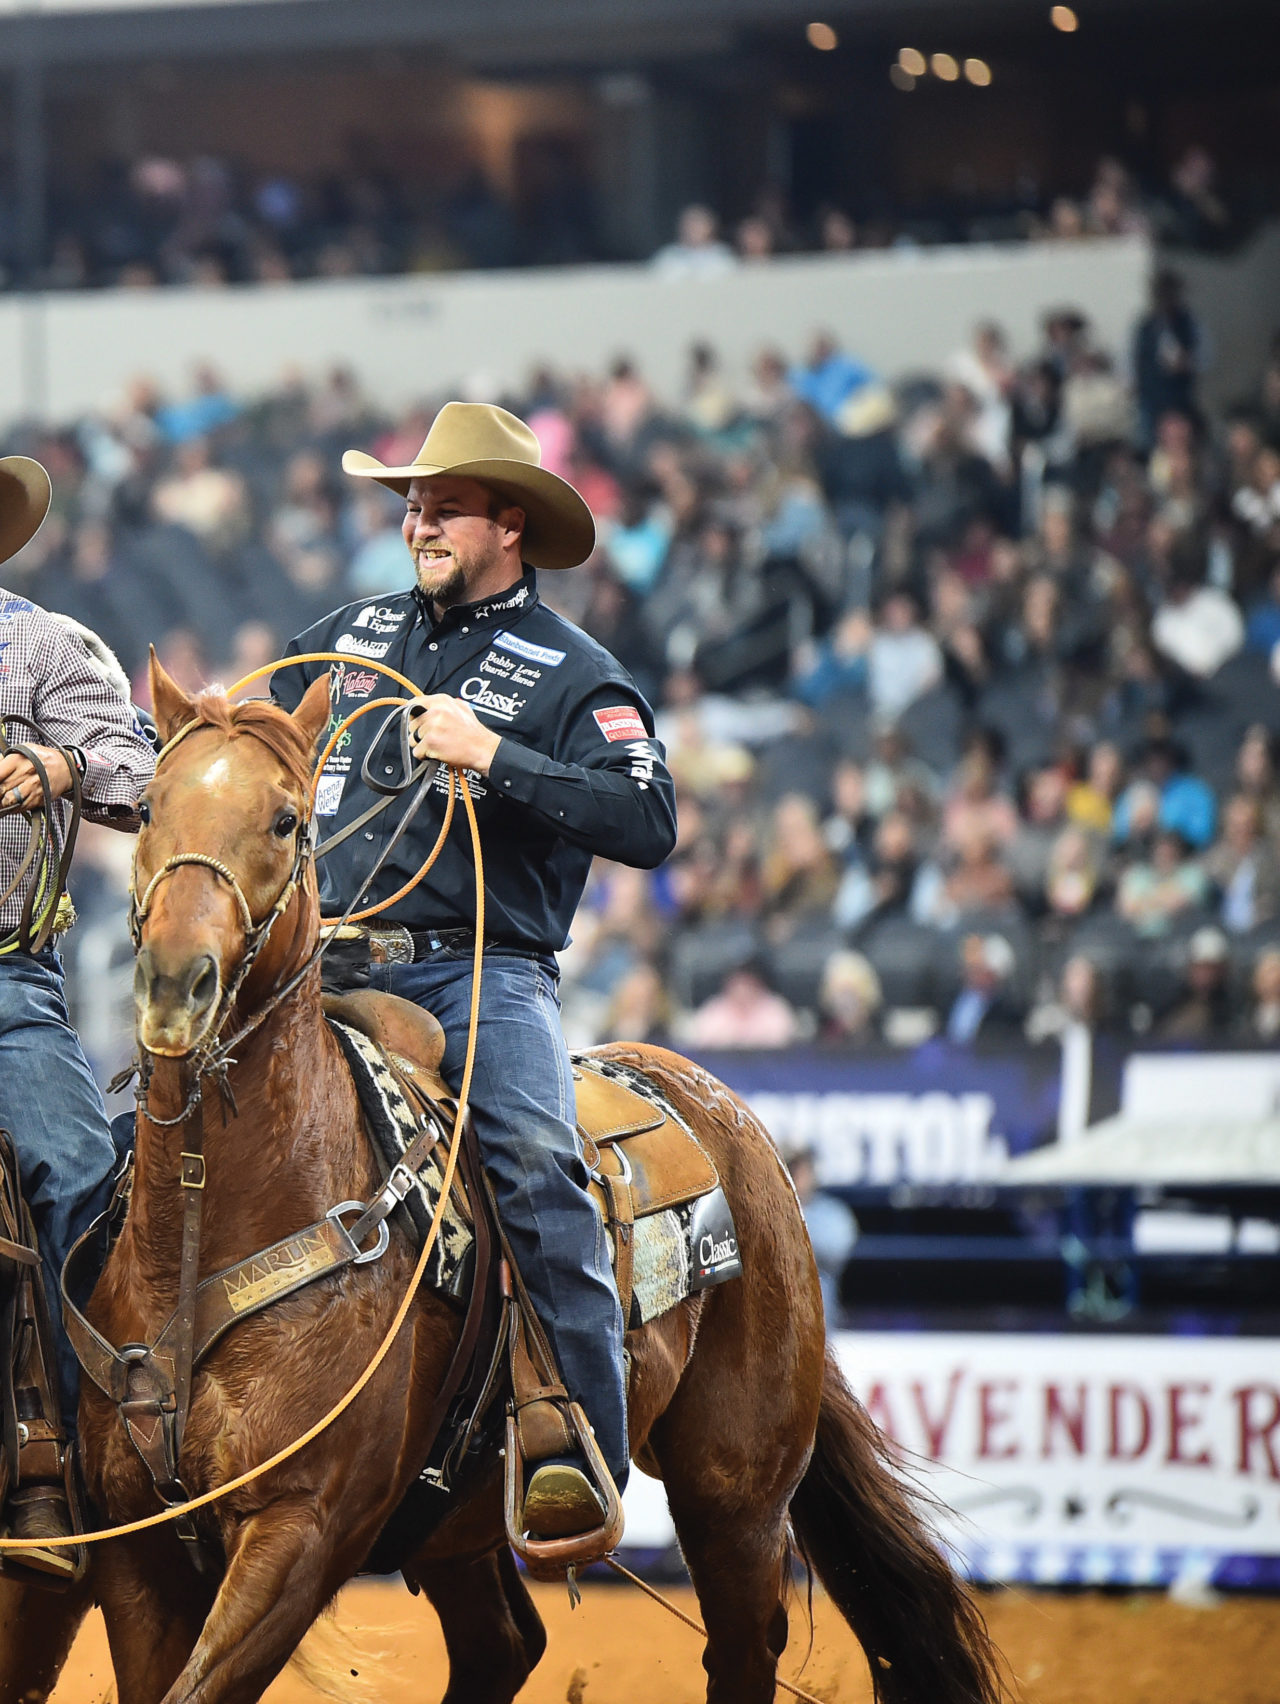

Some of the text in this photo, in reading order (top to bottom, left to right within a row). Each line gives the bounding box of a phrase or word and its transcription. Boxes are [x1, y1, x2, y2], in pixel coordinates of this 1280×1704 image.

[368, 618, 399, 634] Equine
[375, 607, 406, 621] Classic
[479, 660, 535, 688] Quarter Horses
[485, 651, 541, 679] Bobby Lewis
[460, 677, 523, 715] Classic
[222, 1230, 328, 1297] MARTIN
[699, 1230, 738, 1266] Classic
[860, 1365, 1280, 1483] AVENDER
